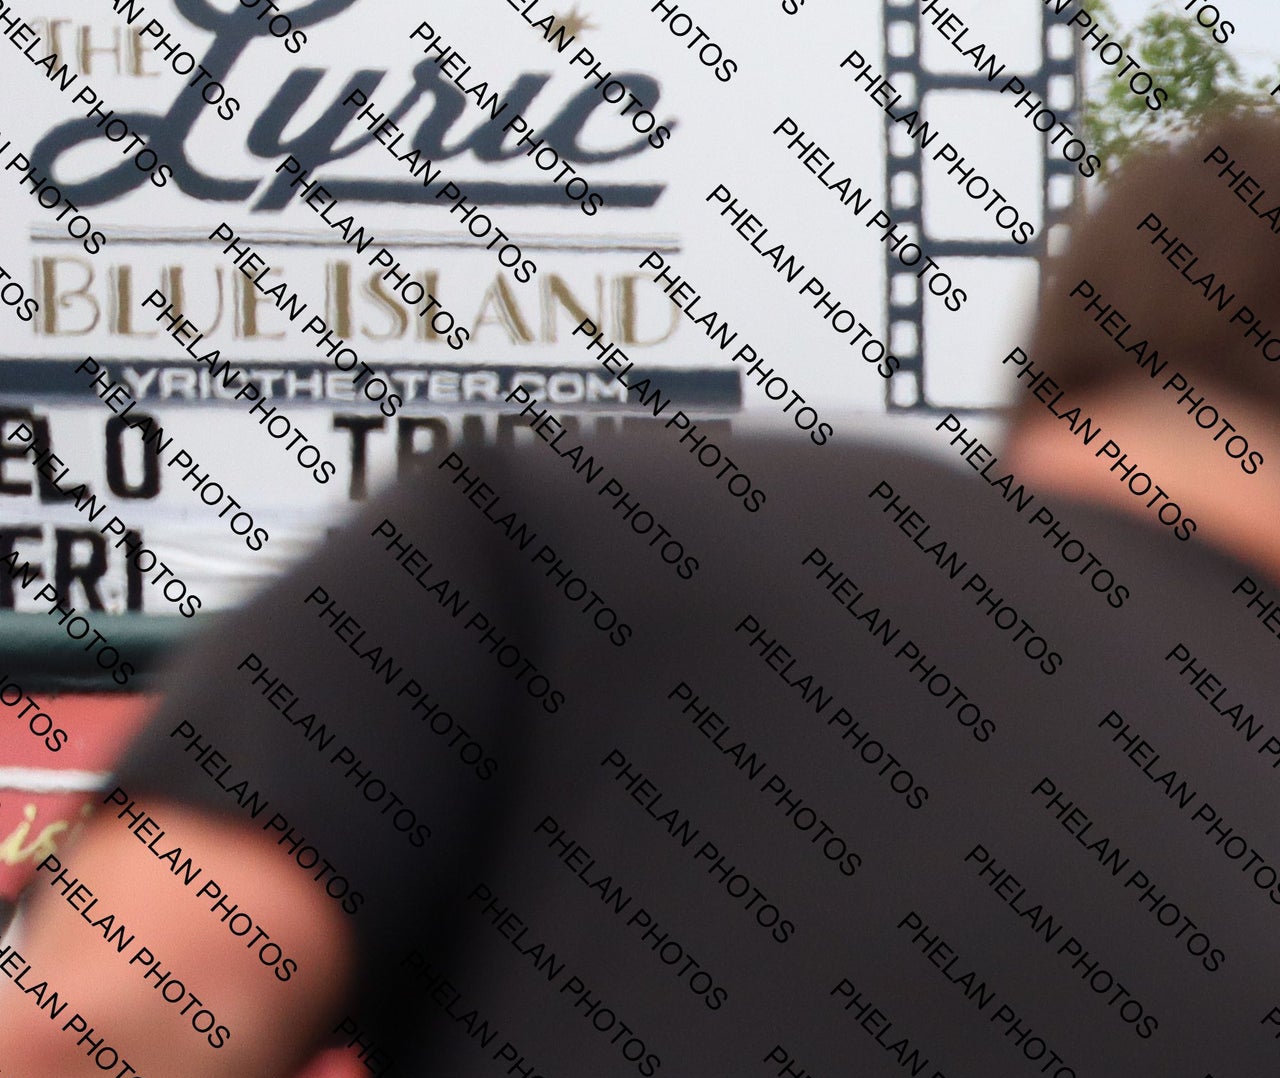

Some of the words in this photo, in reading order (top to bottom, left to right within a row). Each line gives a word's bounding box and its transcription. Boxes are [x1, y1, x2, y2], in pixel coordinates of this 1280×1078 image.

[28, 18, 161, 77] THE
[27, 0, 679, 214] Lyric
[31, 255, 287, 340] BLUE
[326, 260, 681, 346] ISLAND
